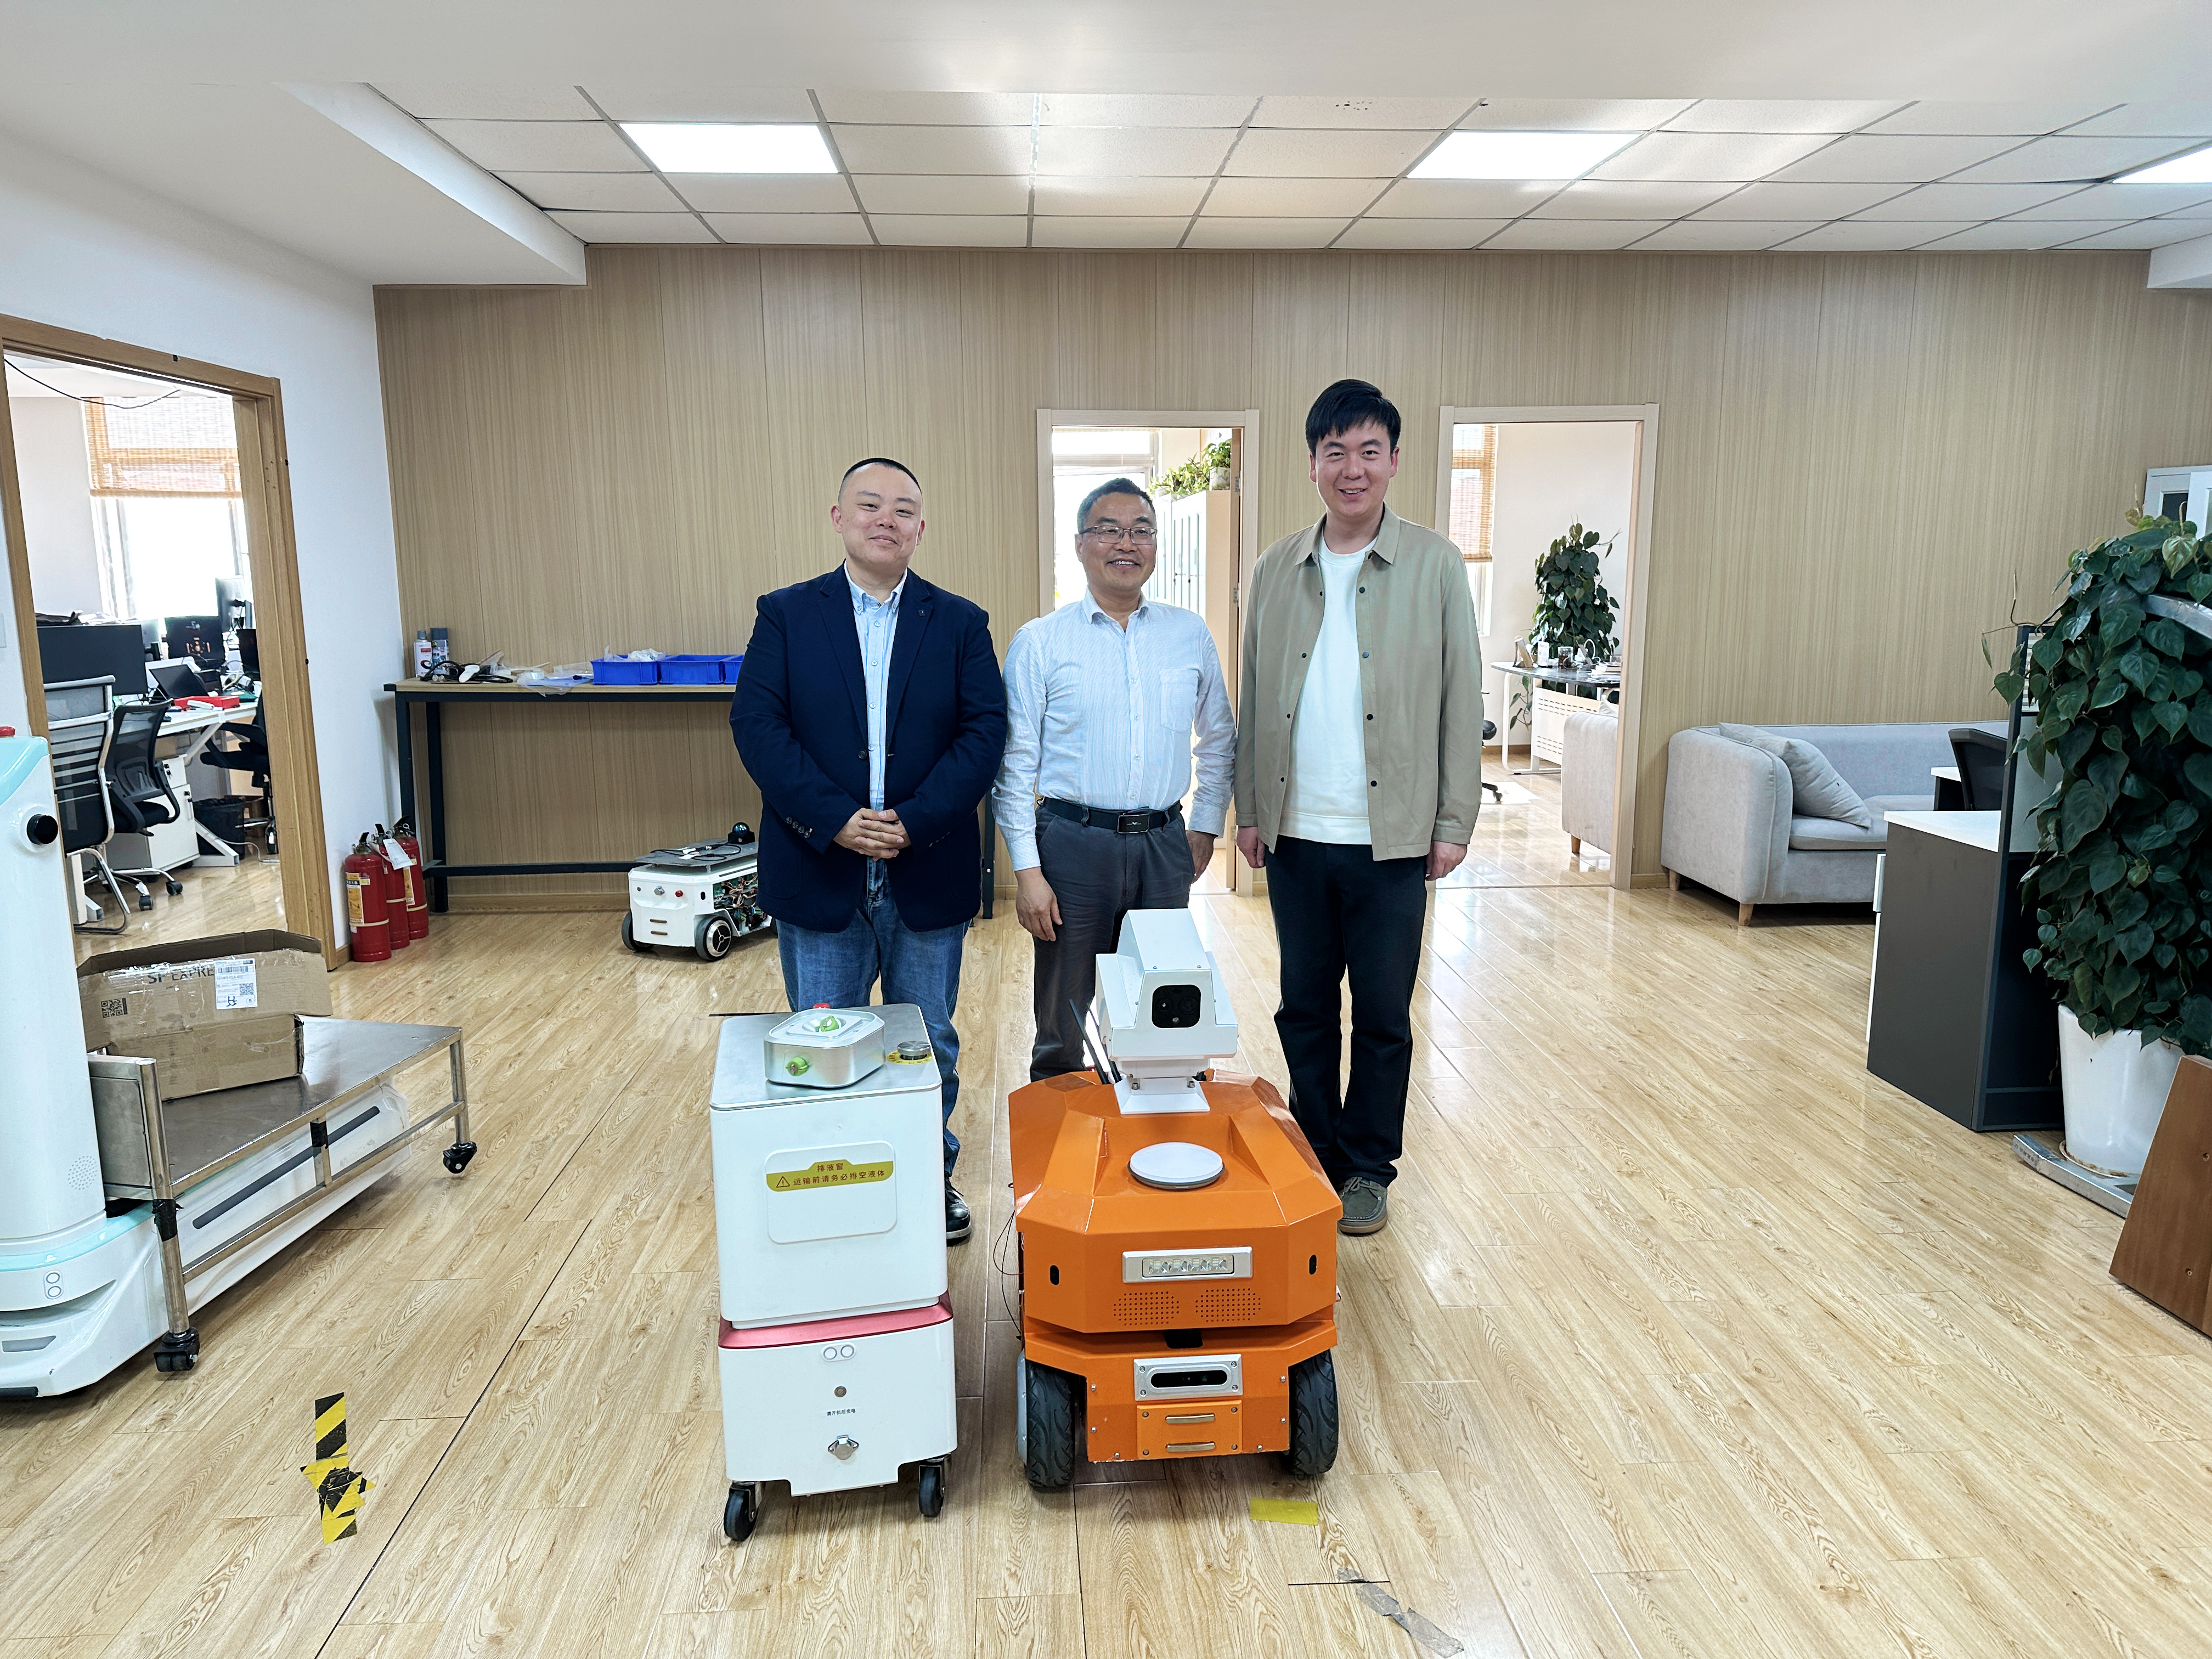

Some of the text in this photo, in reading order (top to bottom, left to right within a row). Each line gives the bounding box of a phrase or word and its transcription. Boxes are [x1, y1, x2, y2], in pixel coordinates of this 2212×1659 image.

[171, 967, 215, 981] EXPRE
[793, 1169, 885, 1186] 运输前请务必排空液体
[826, 1408, 856, 1416] 请开机后充电
